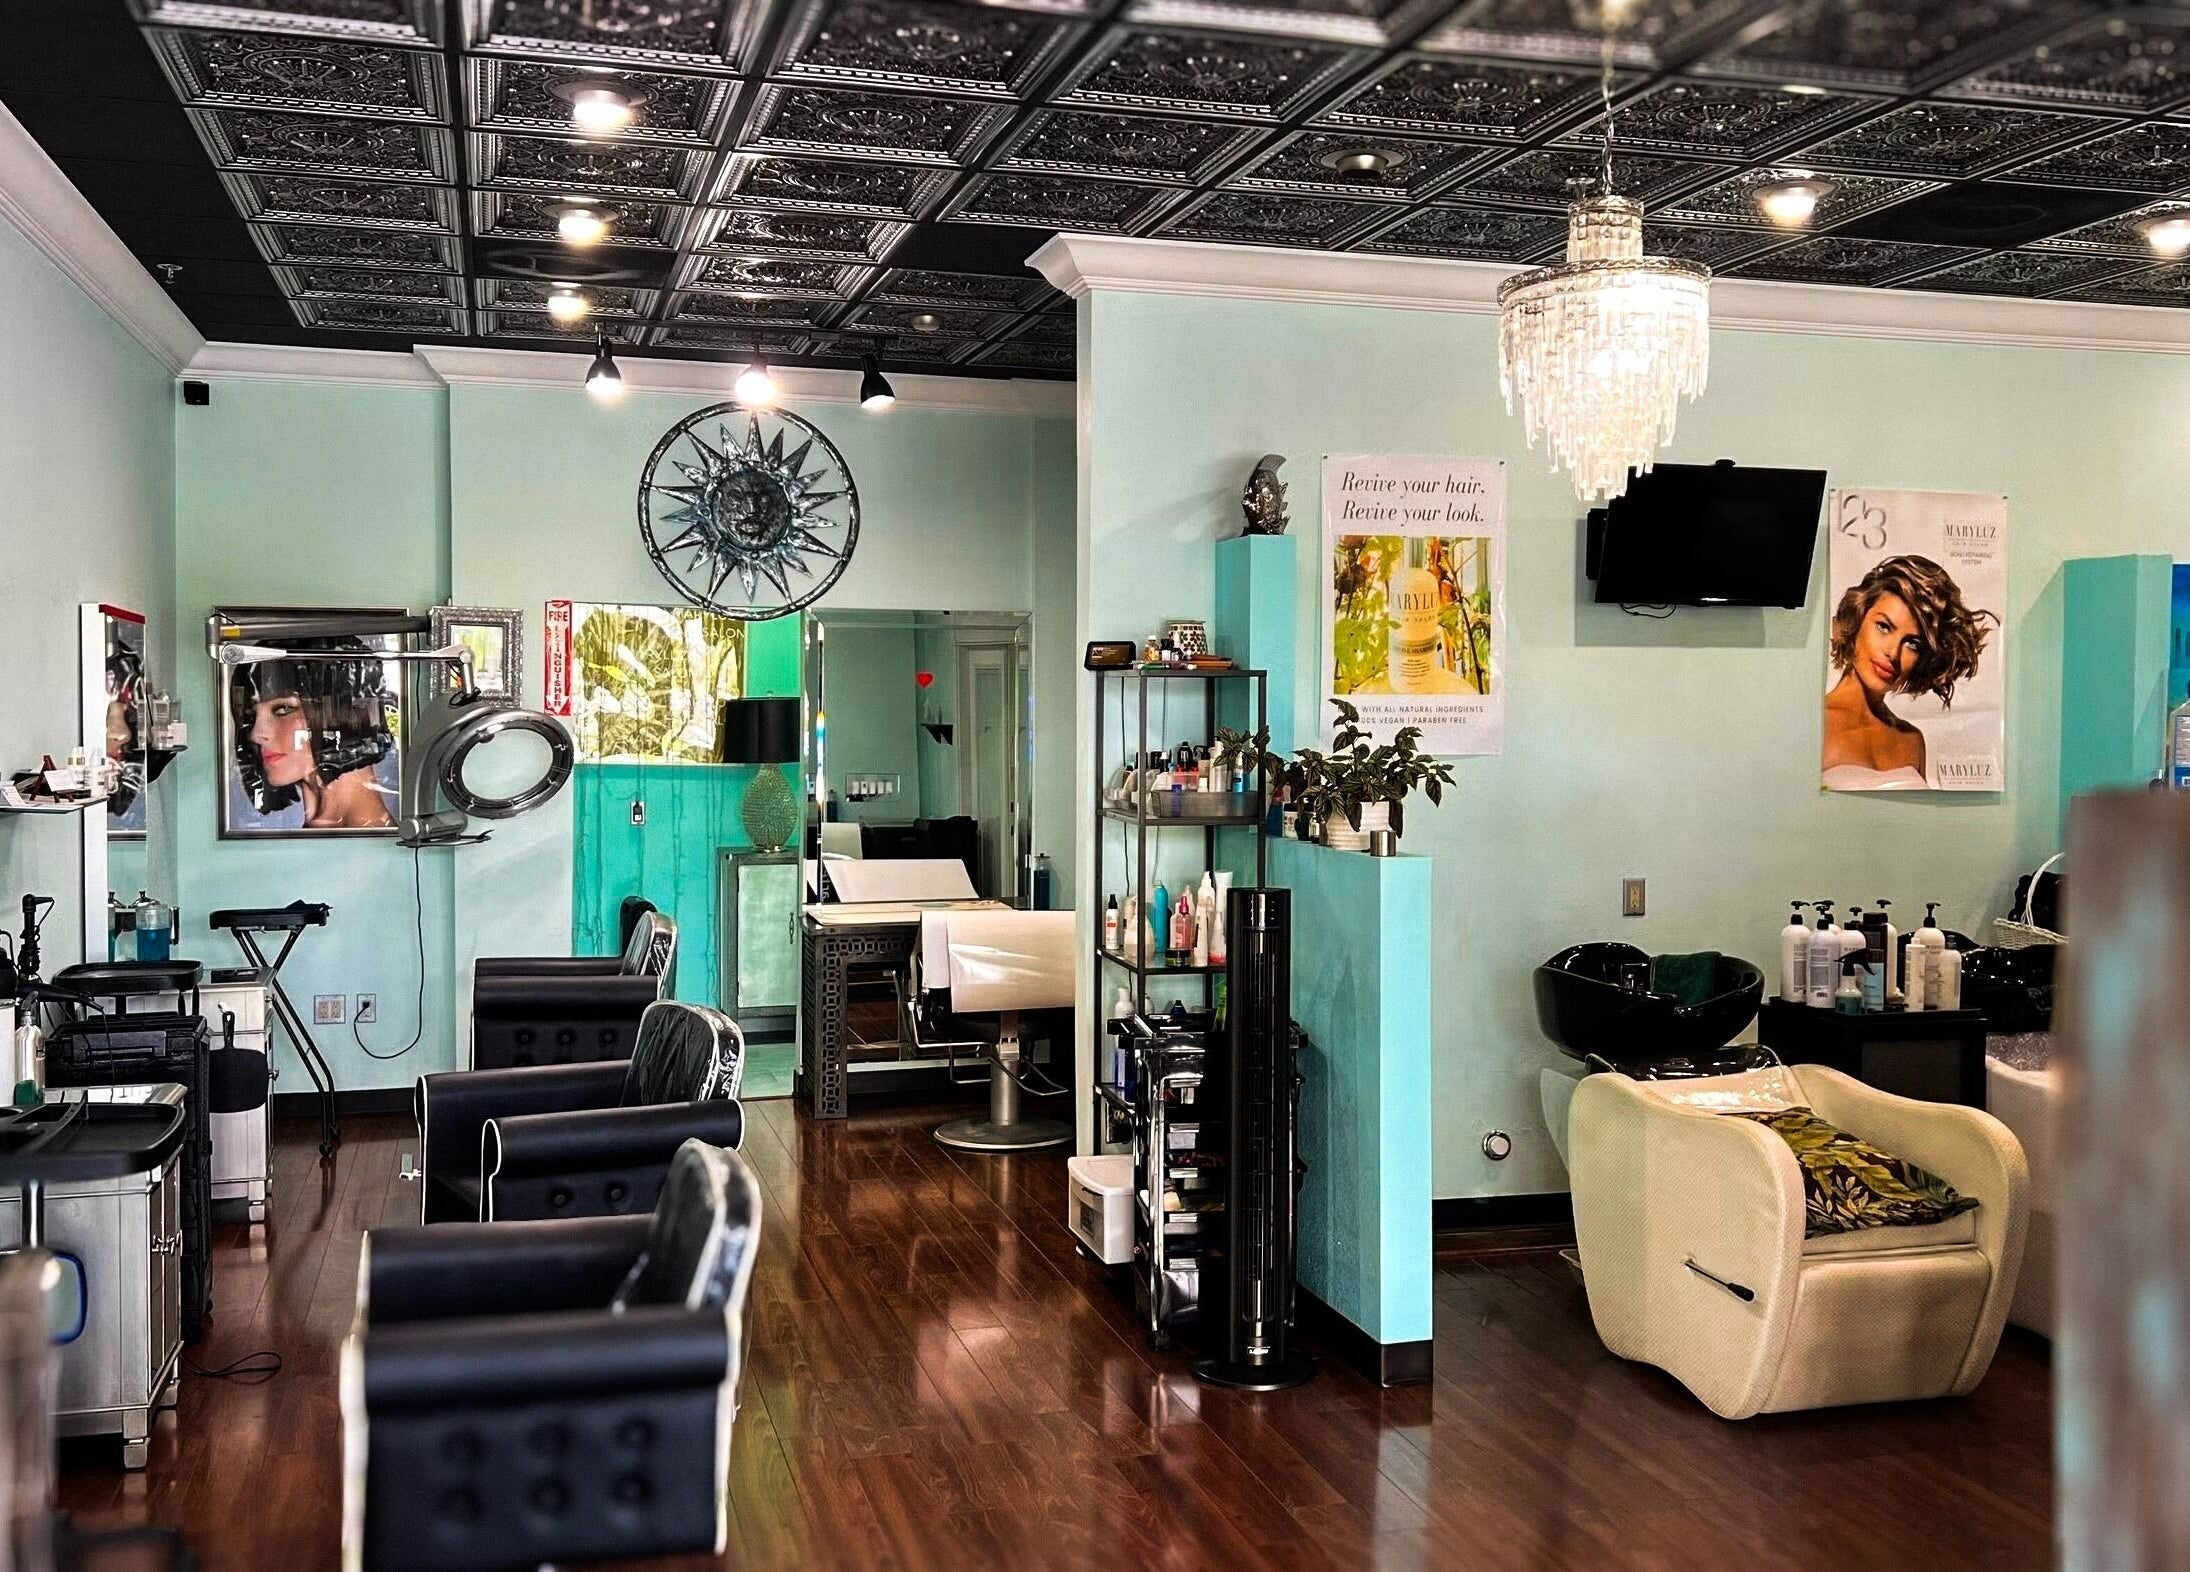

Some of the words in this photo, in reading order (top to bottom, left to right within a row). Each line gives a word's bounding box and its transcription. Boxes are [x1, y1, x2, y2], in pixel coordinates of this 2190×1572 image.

[1341, 471, 1397, 492] Revive
[1400, 479, 1440, 499] your
[1445, 474, 1486, 494] hair.
[1342, 500, 1397, 521] Revive
[1400, 508, 1441, 528] your
[1445, 502, 1485, 523] look.
[1946, 523, 1997, 540] MARYLUZ
[1390, 592, 1438, 612] ARYLU
[548, 610, 569, 622] FIRE
[553, 625, 562, 707] INGUISHER
[1940, 764, 1992, 777] MARYLUZ
